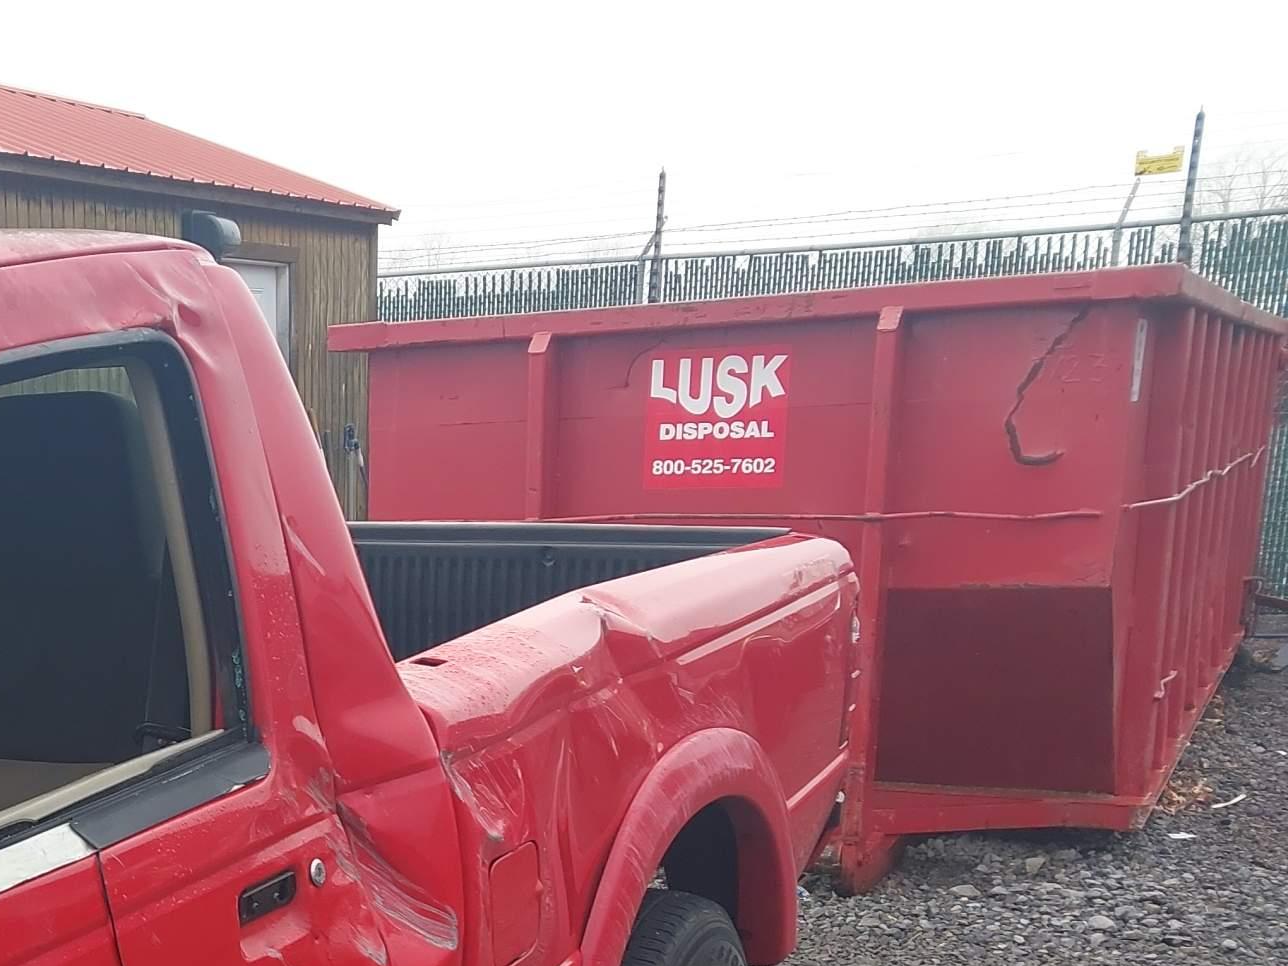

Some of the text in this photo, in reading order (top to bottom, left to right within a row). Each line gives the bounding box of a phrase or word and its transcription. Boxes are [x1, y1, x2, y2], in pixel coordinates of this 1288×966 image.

[650, 354, 789, 418] LUSK
[659, 420, 775, 441] DISPOSAL
[651, 457, 776, 475] 800-525-7602
